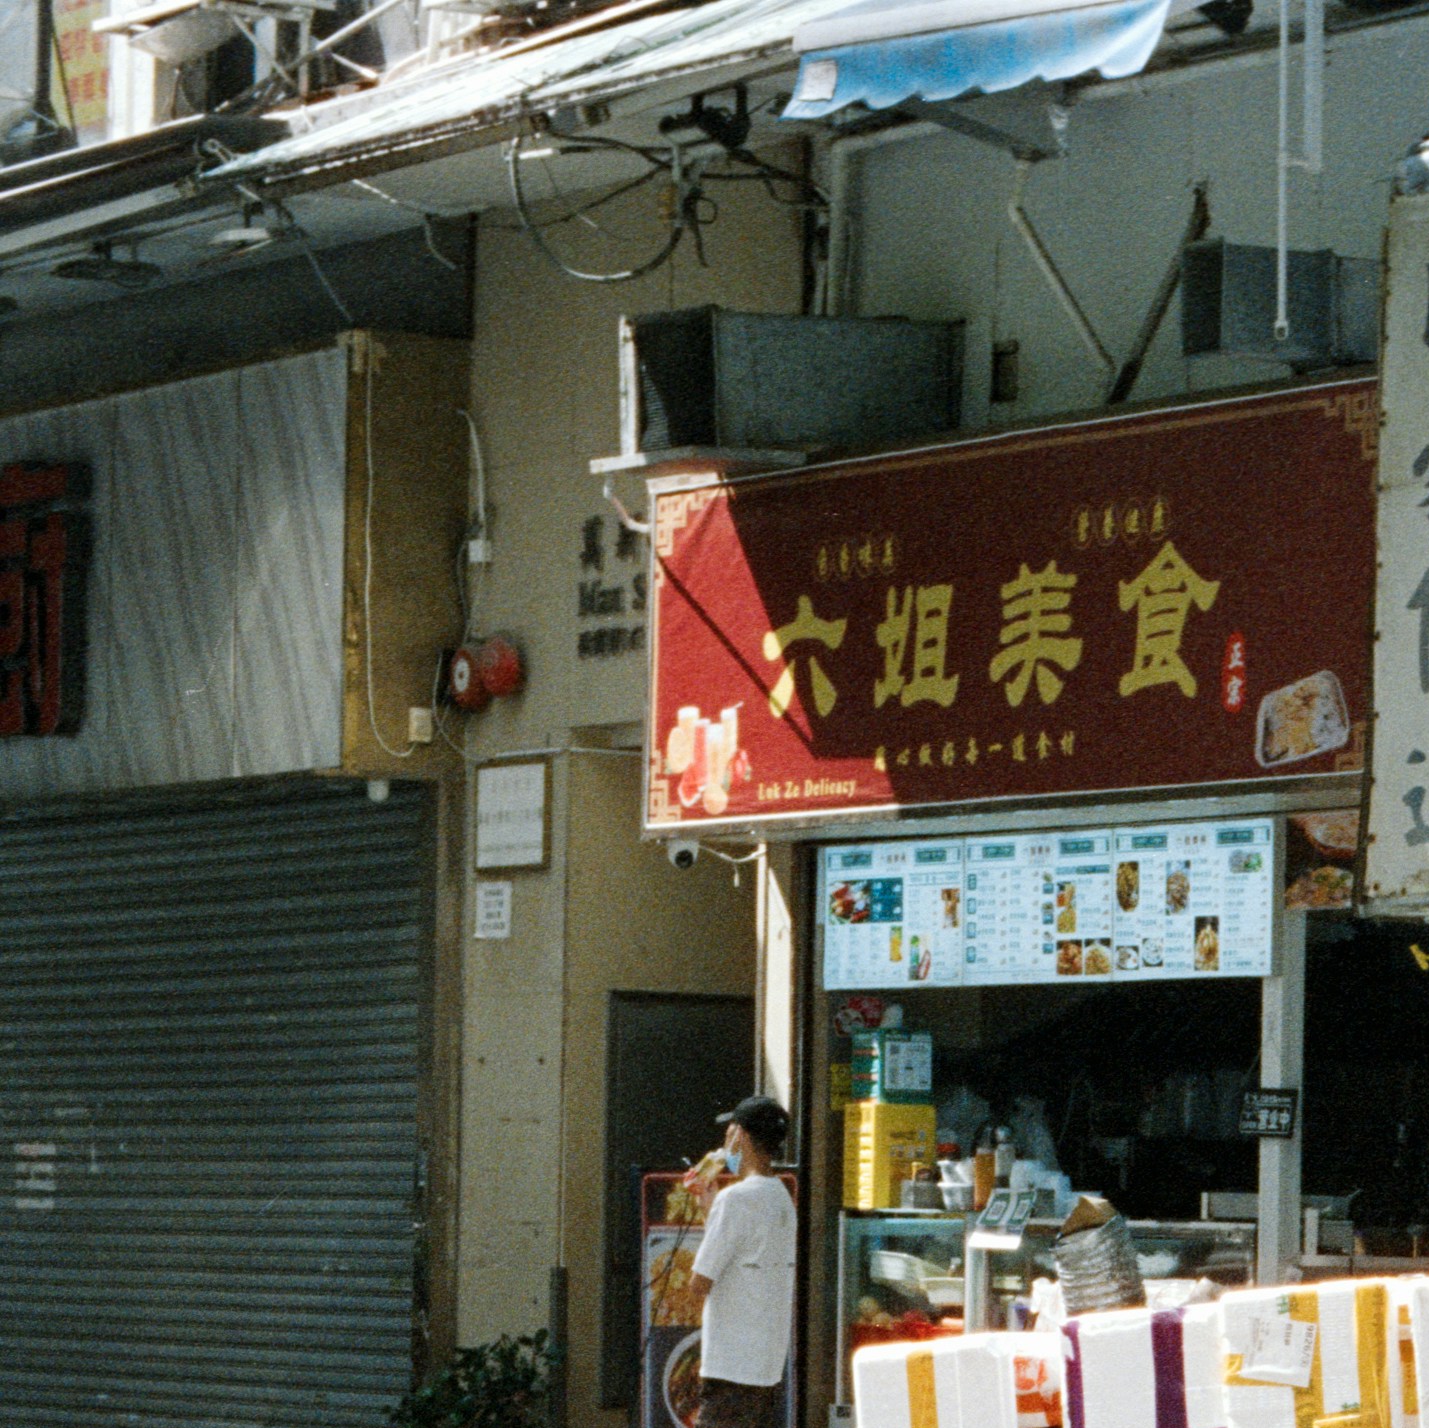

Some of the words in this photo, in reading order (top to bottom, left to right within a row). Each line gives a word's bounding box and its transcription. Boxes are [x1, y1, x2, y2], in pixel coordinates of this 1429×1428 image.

[762, 542, 1221, 718] 六姐美食
[758, 781, 781, 800] Luk
[804, 778, 857, 798] Delicacy
